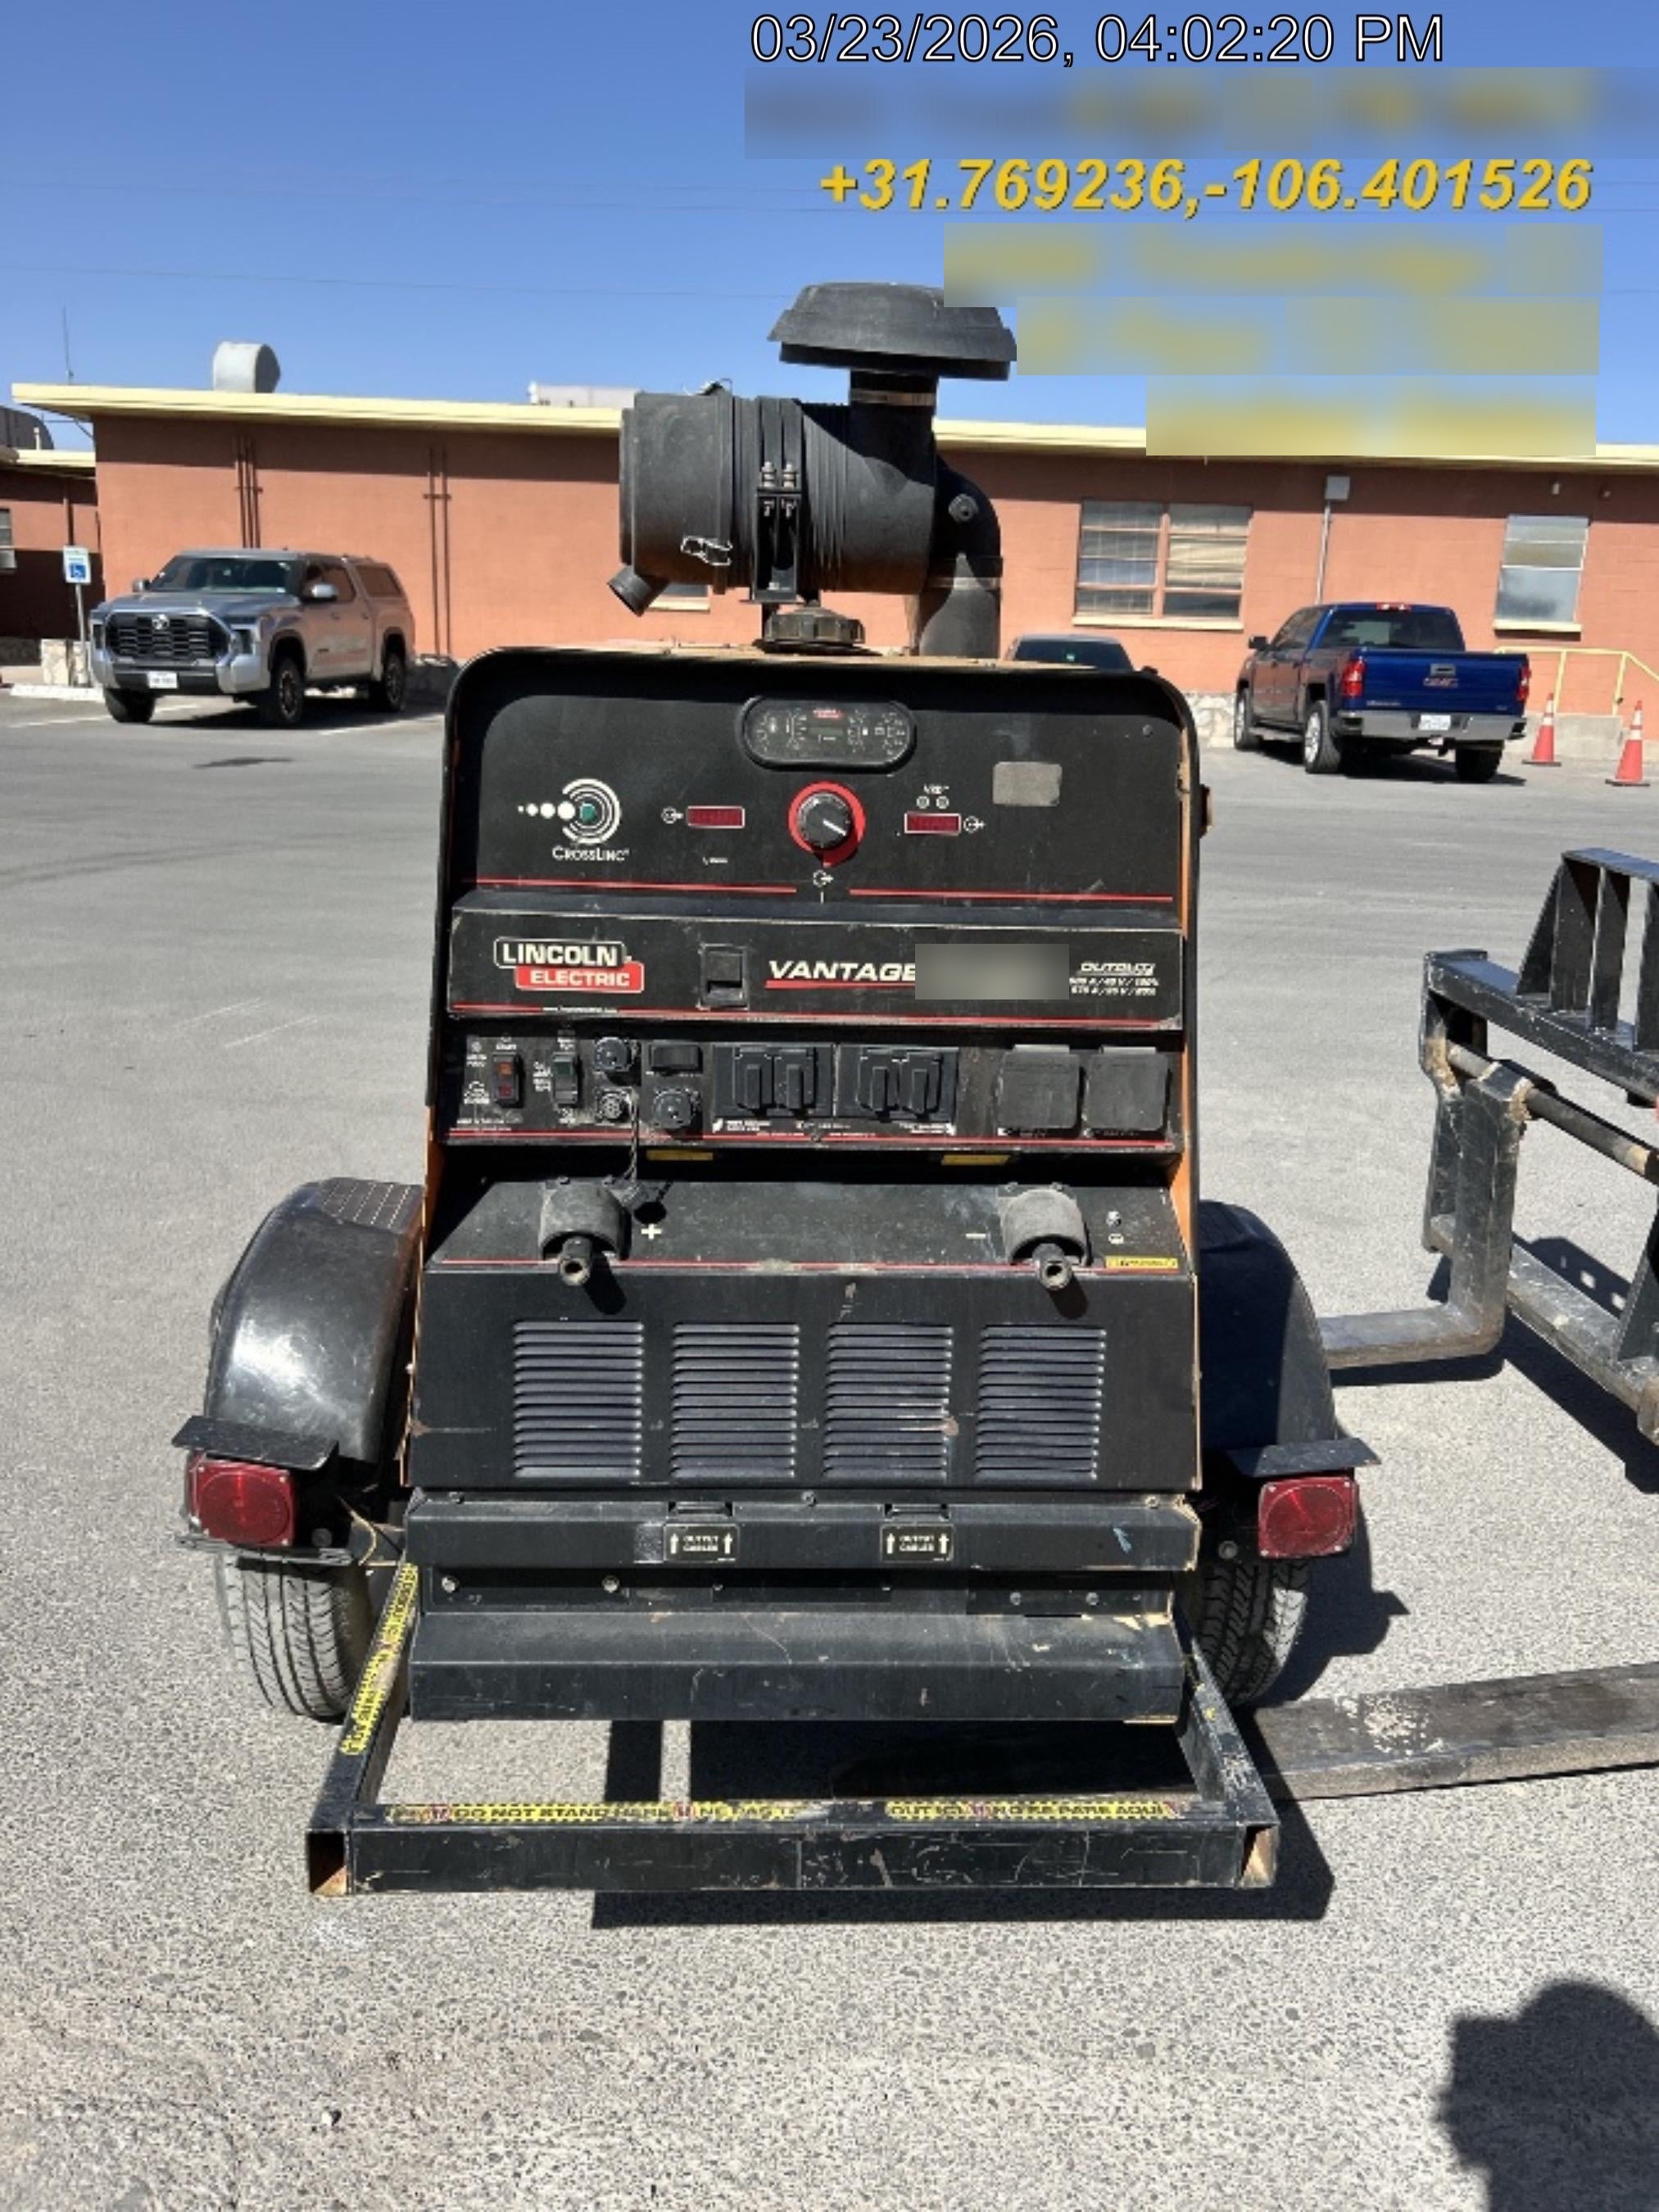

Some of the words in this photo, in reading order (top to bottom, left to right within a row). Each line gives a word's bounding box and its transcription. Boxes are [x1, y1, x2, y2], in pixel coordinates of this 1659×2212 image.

[503, 943, 617, 967] LINCOLN
[530, 969, 630, 987] ELECTRIC
[768, 960, 915, 981] VANTAGE
[454, 1808, 487, 1817] DO
[491, 1808, 536, 1817] NOT
[539, 1807, 610, 1817] STAND
